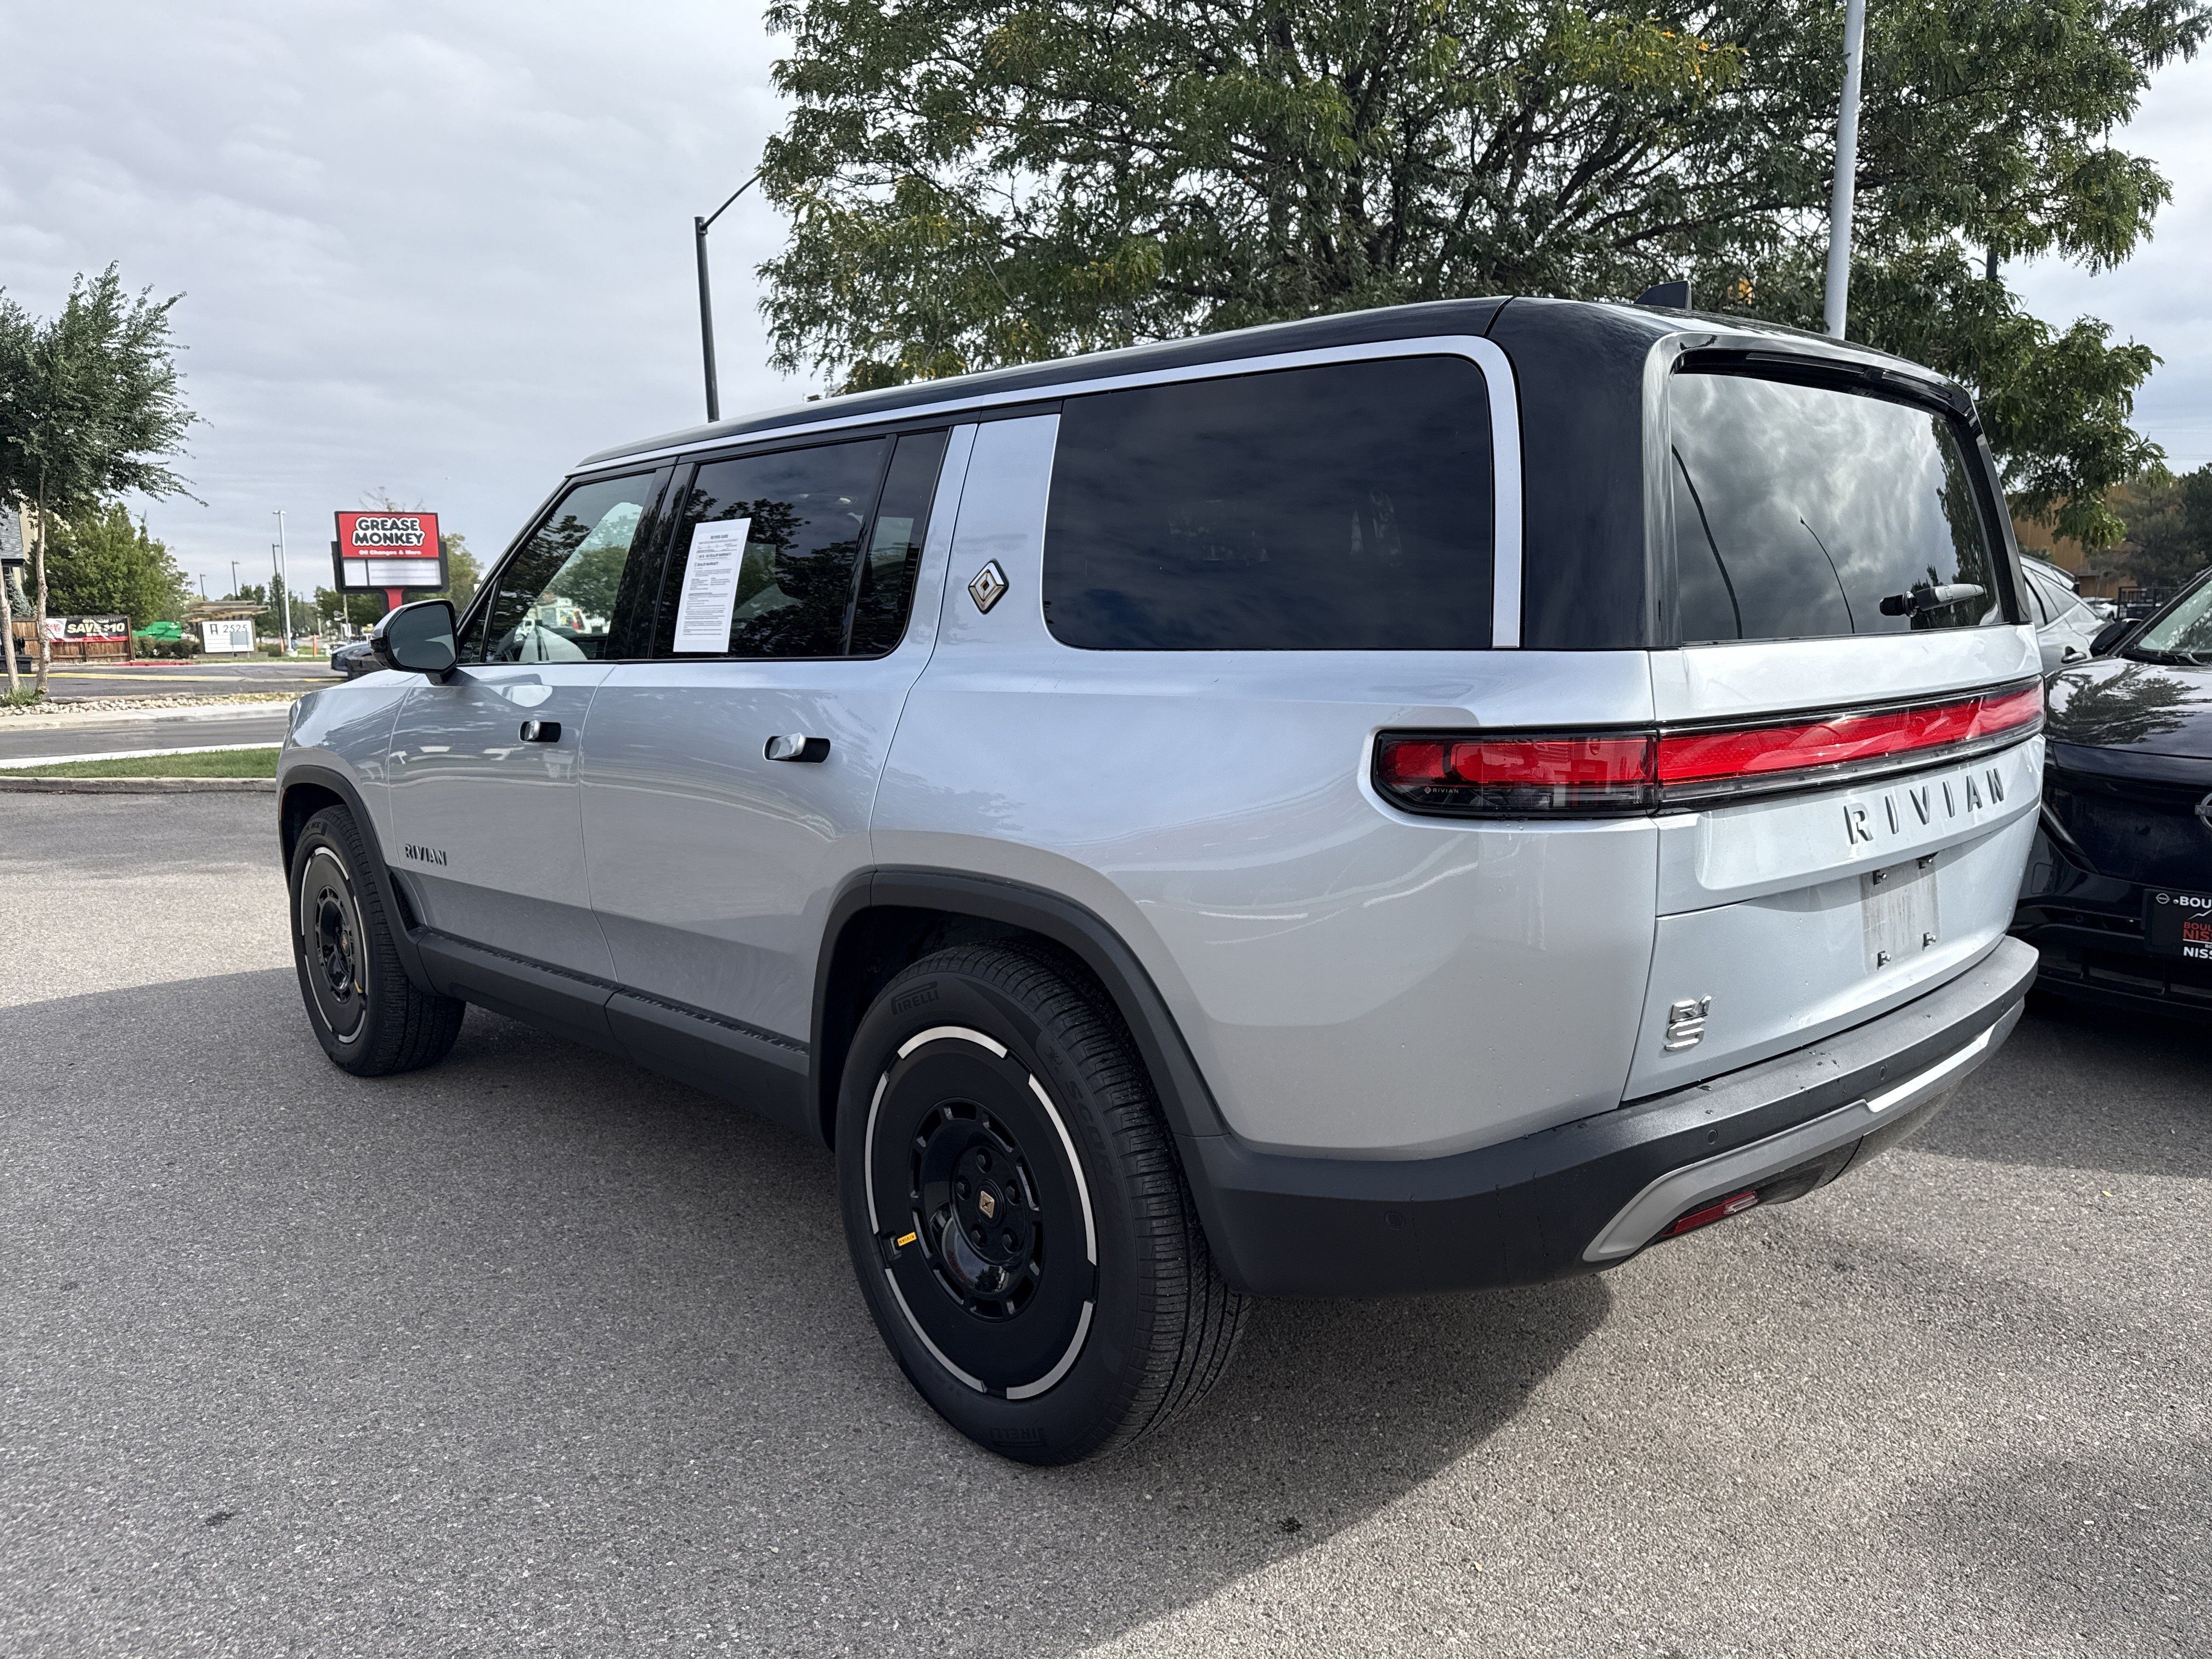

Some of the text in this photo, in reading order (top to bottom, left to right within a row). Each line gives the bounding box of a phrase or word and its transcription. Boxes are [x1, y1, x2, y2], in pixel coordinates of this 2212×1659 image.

[358, 519, 419, 532] GREASE
[354, 533, 423, 544] MONKEY
[223, 624, 248, 633] 2525
[1843, 768, 2004, 844] RIVIAN
[405, 844, 447, 866] RIVIAN
[2183, 929, 2212, 941] NIS
[890, 981, 940, 1015] PIRELLI
